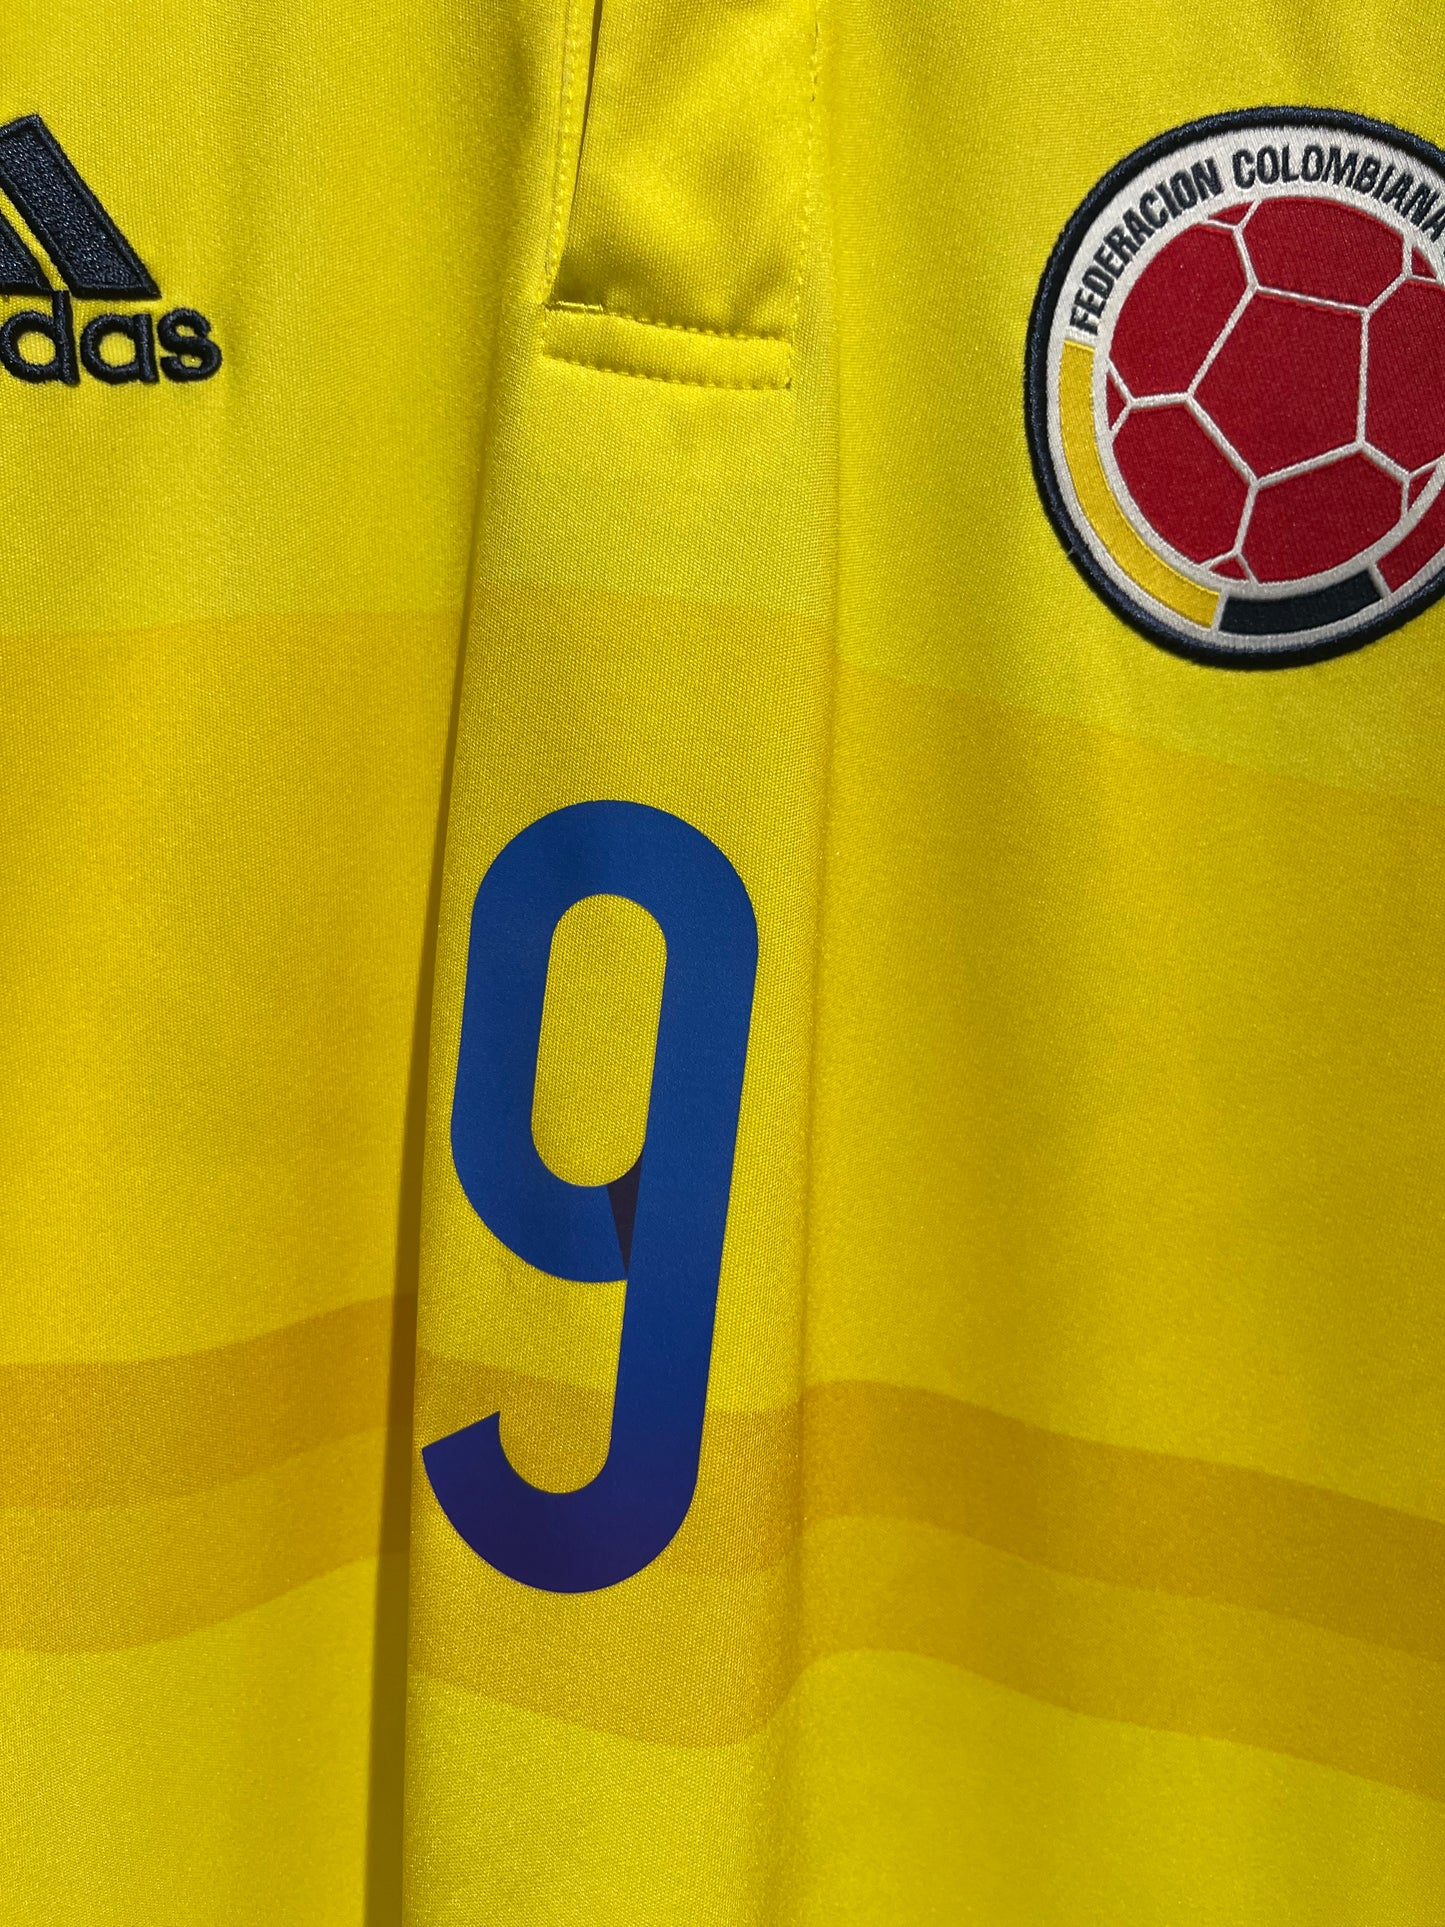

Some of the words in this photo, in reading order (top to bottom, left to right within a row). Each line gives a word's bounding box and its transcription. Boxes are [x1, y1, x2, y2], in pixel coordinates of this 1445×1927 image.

[1069, 157, 1223, 335] FEDERACION
[0, 290, 222, 386] das
[422, 800, 759, 1593] 9
